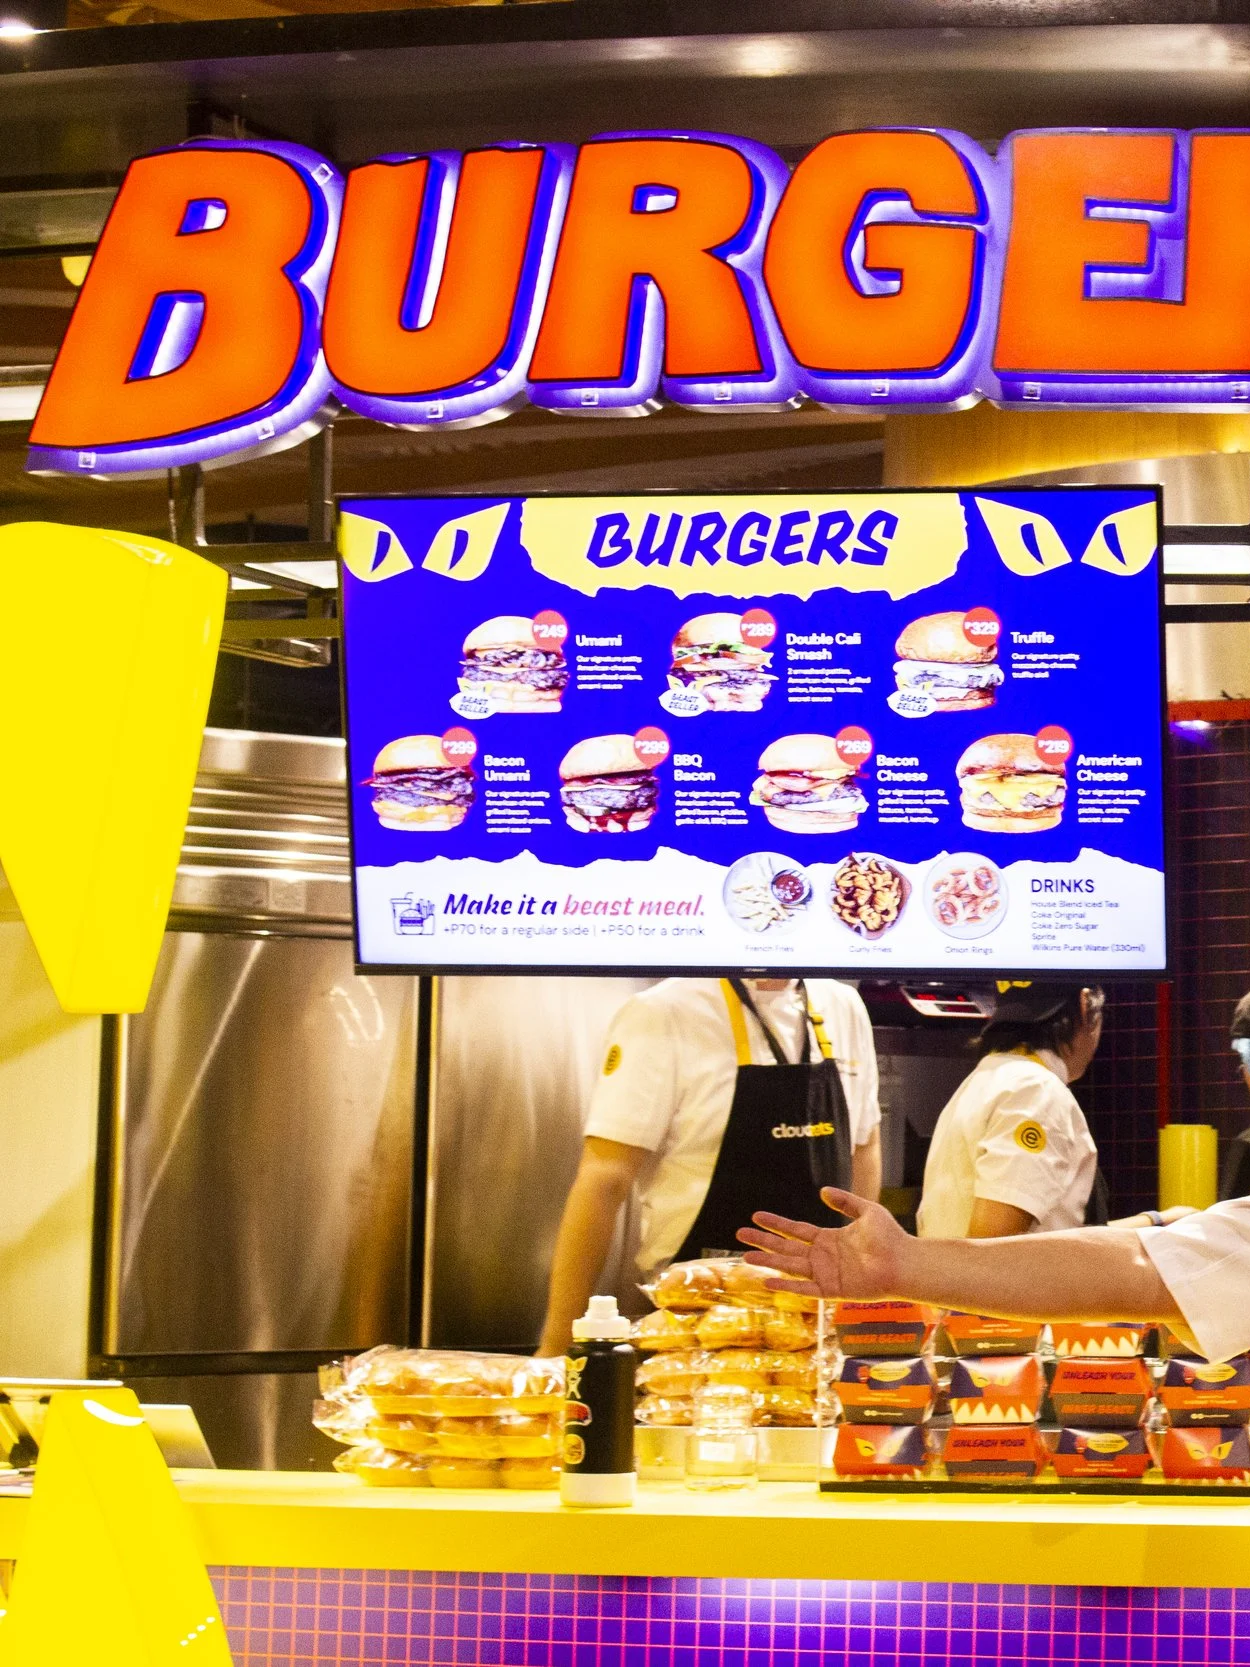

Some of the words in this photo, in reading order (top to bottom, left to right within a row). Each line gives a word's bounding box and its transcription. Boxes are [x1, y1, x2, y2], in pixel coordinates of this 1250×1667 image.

[585, 509, 899, 568] BURGERS
[576, 635, 622, 647] Umami
[786, 633, 834, 645] Double
[1010, 632, 1055, 644] Truffle
[787, 649, 832, 660] Smash
[484, 755, 525, 766] Bacon
[673, 754, 702, 767] BBQ
[877, 754, 919, 766] Bacon
[1077, 754, 1142, 766] American
[484, 770, 531, 781] Umami
[674, 769, 716, 781] Bacon
[877, 770, 928, 782] Cheese
[1077, 770, 1128, 782] Cheese
[1031, 879, 1095, 893] DRINKS
[443, 893, 512, 916] Make
[518, 894, 537, 915] it
[541, 899, 557, 916] a
[562, 894, 633, 916] beast
[637, 894, 705, 917] meal.
[479, 924, 498, 936] for
[501, 927, 509, 936] a
[512, 924, 557, 939] regular
[562, 925, 589, 937] side
[637, 925, 656, 937] for
[660, 927, 668, 937] a
[672, 924, 705, 936] drink
